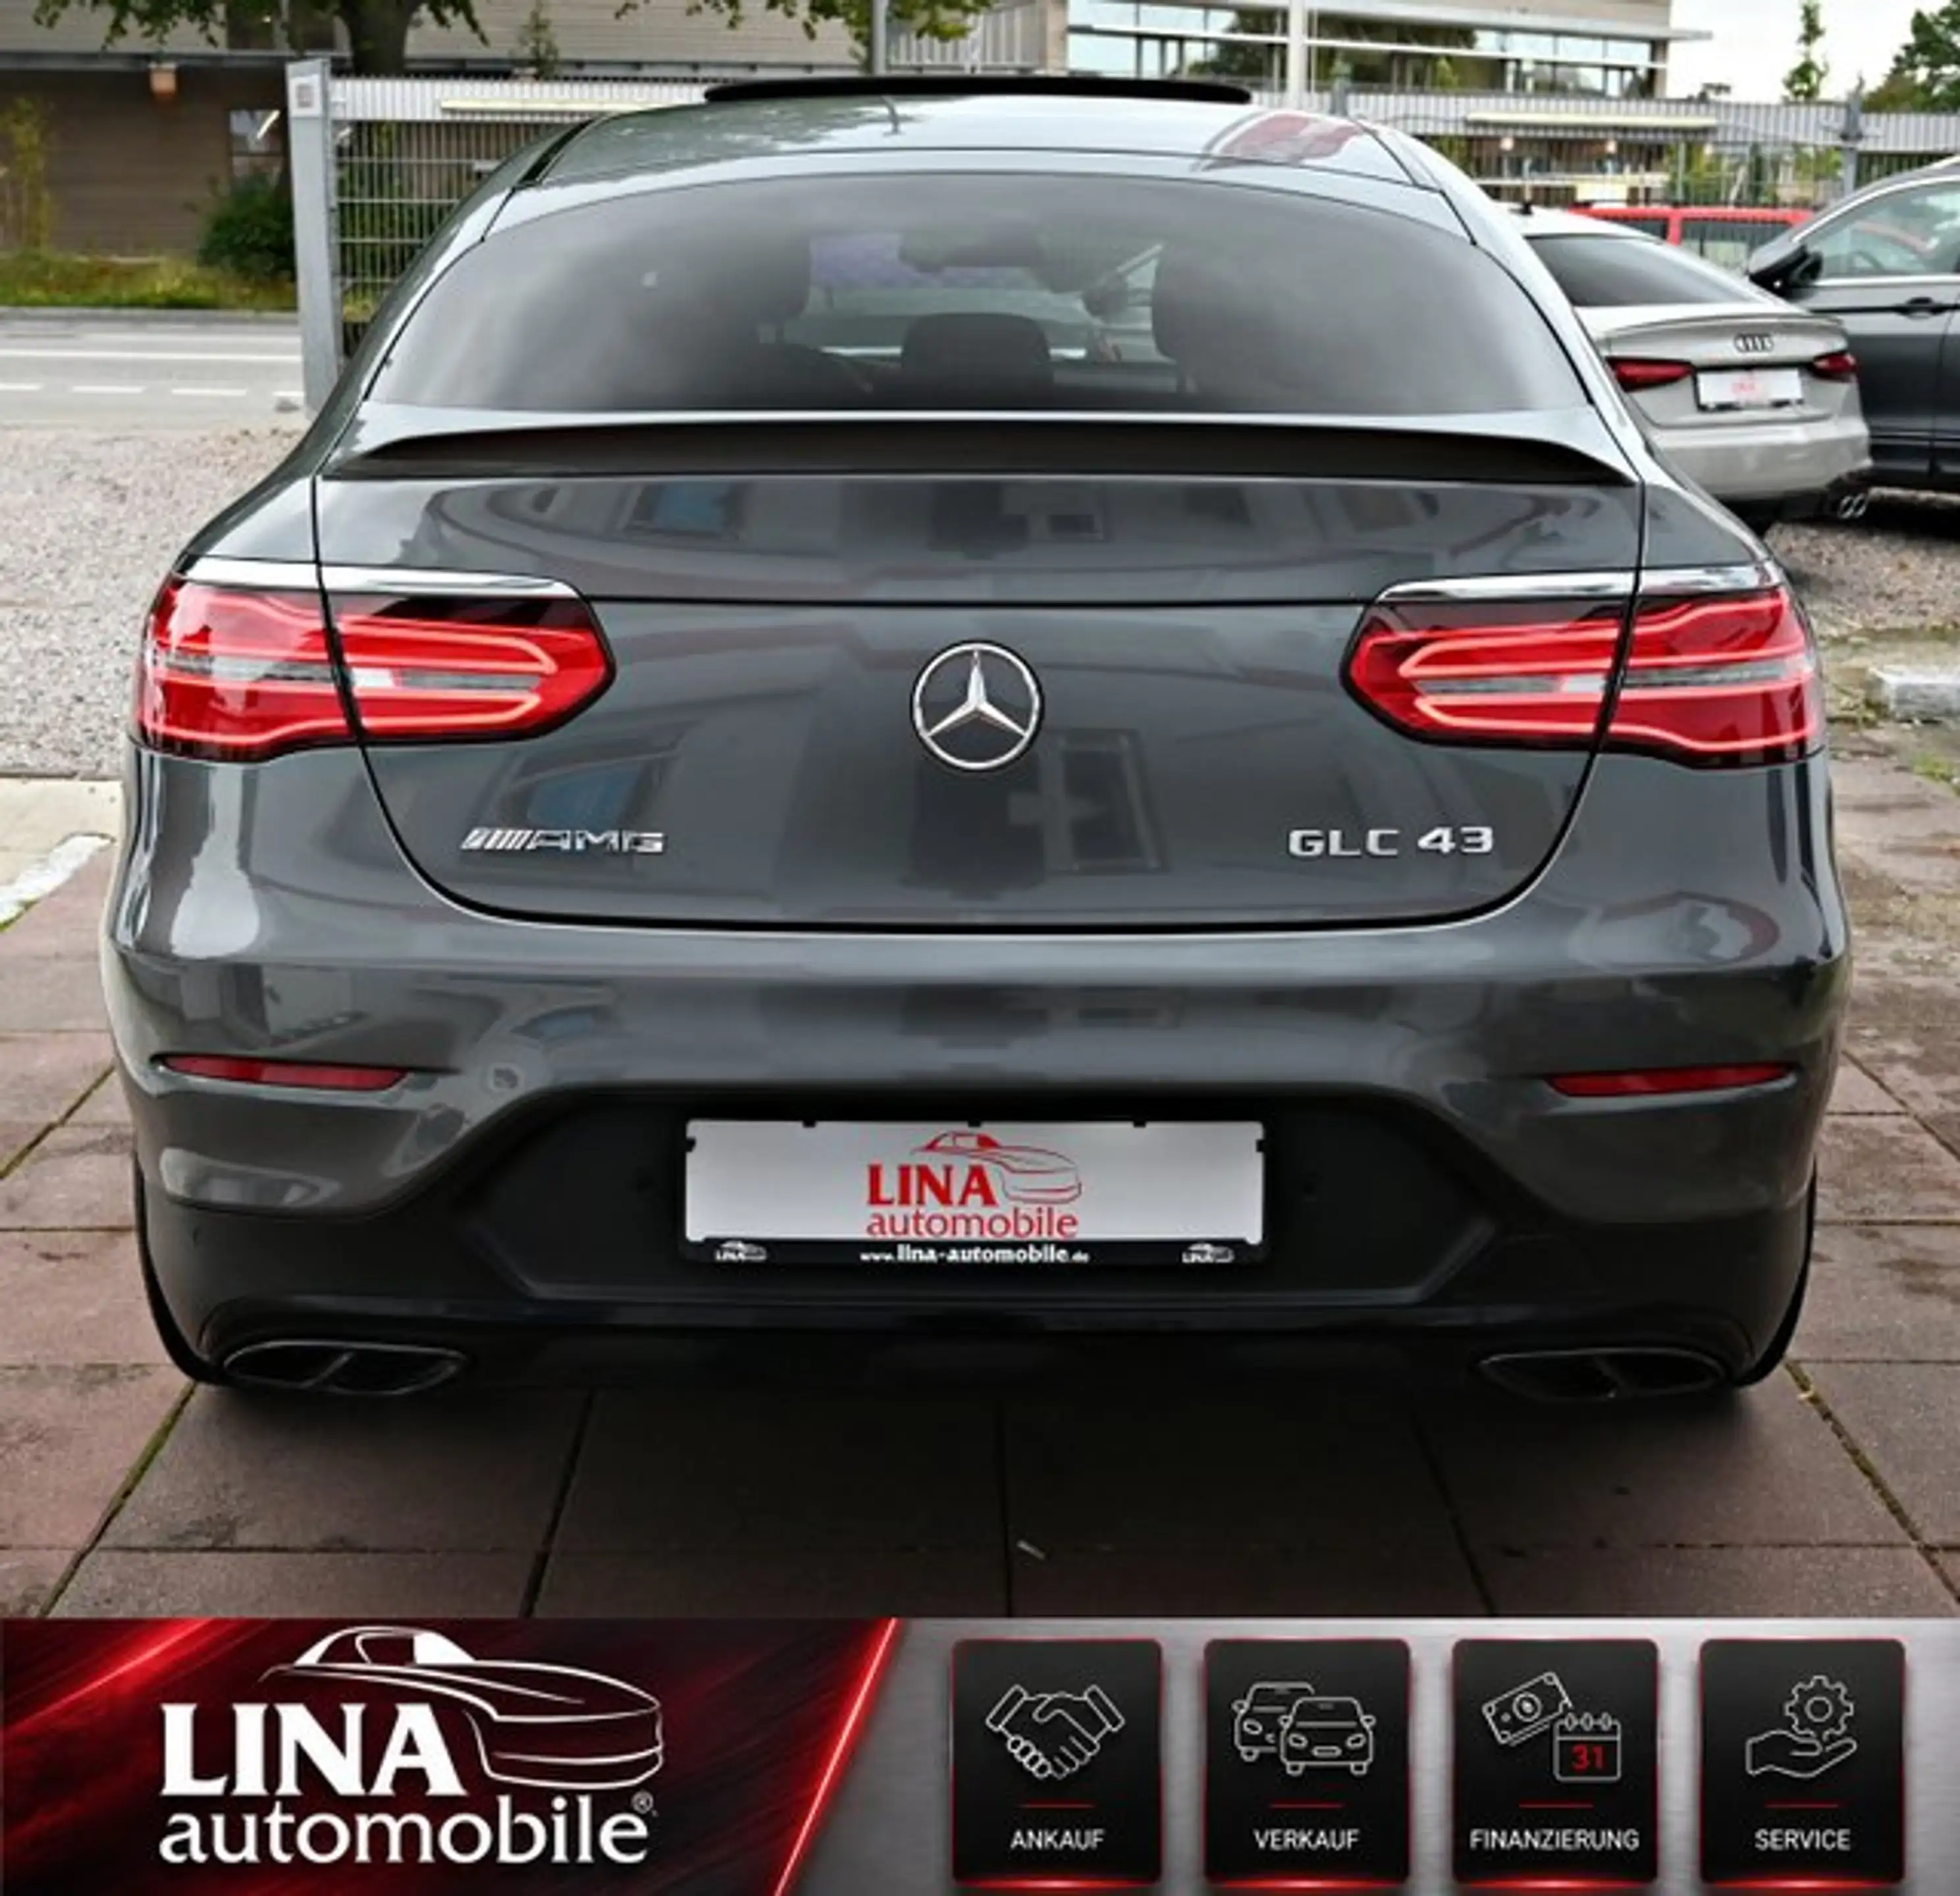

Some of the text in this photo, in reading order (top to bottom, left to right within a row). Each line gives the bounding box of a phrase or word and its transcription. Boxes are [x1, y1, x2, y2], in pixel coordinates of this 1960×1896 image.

[527, 829, 664, 853] AMG
[1288, 826, 1494, 856] GLC 43
[866, 1164, 999, 1207] LINA
[866, 1206, 1079, 1238] automobile
[860, 1244, 1090, 1263] www.lina-automobile.de
